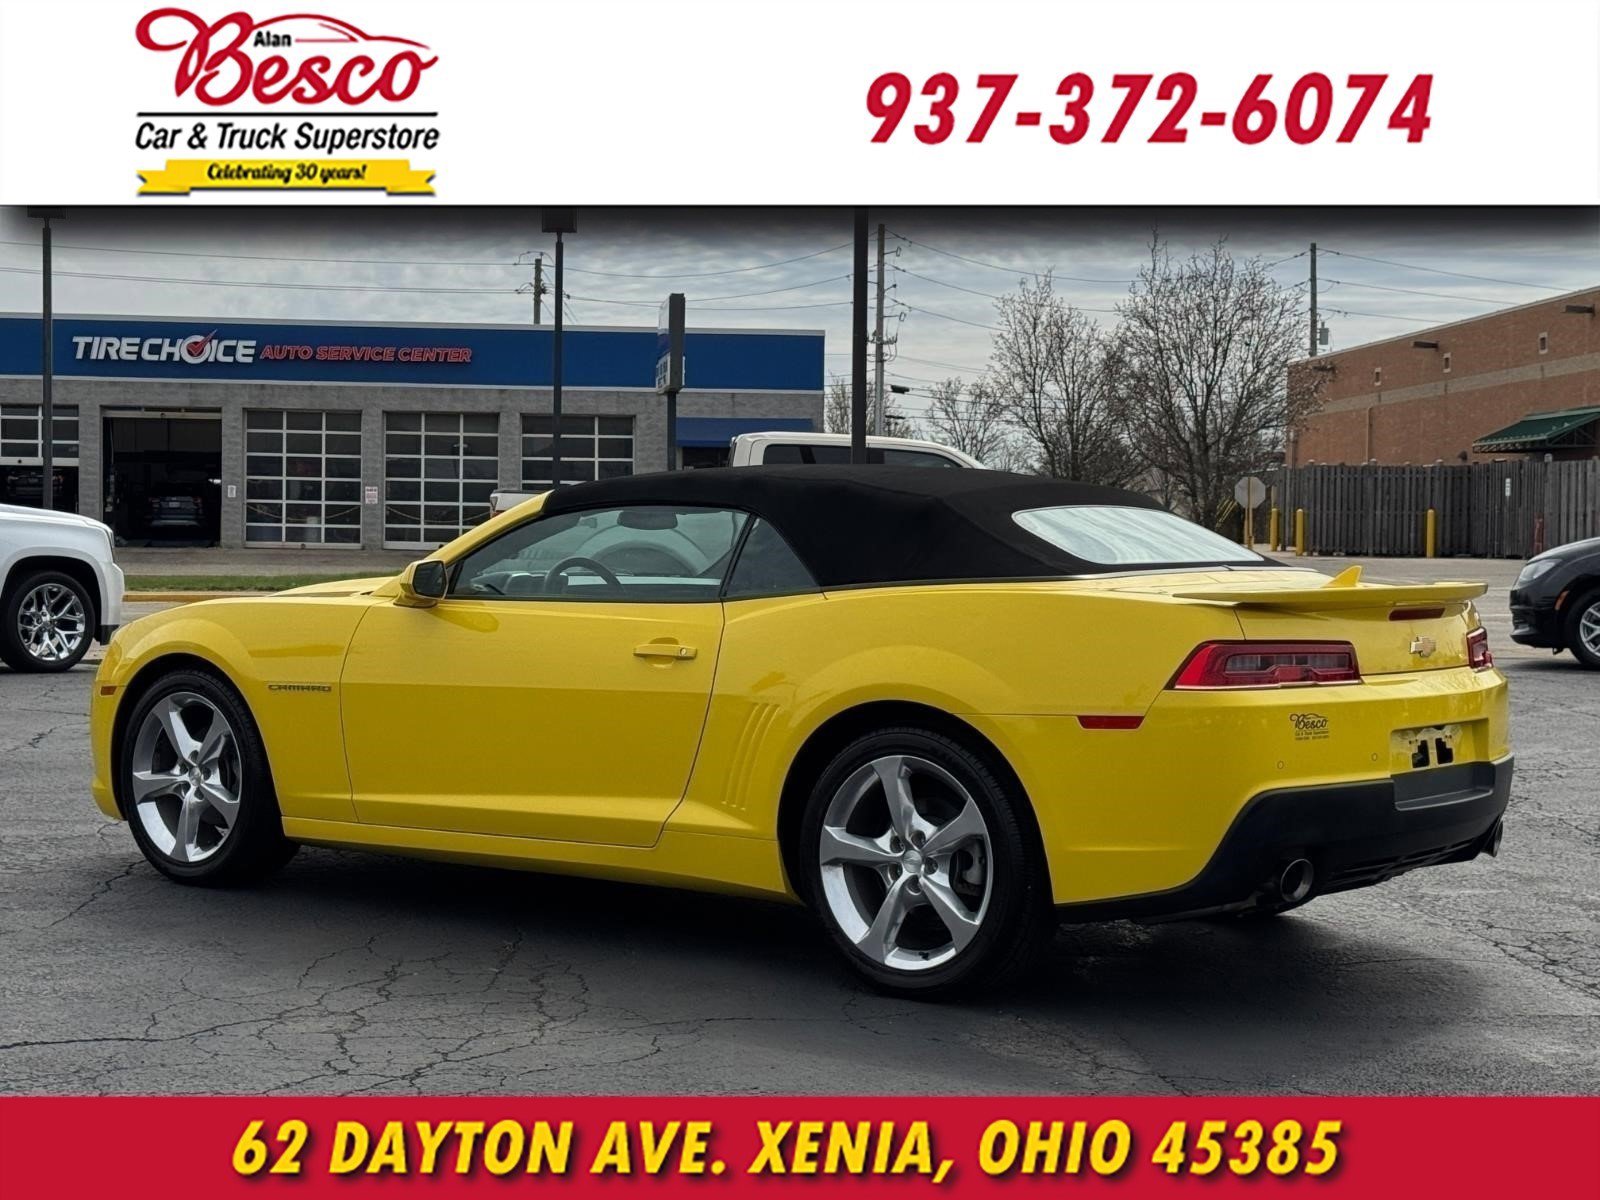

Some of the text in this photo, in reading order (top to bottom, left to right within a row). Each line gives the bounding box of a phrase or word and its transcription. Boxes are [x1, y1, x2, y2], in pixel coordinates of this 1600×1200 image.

[260, 345, 313, 360] AUTO
[315, 346, 396, 362] SERVICE
[398, 347, 472, 363] CENTER
[268, 684, 332, 692] CAMARO
[1290, 713, 1328, 730] Besco
